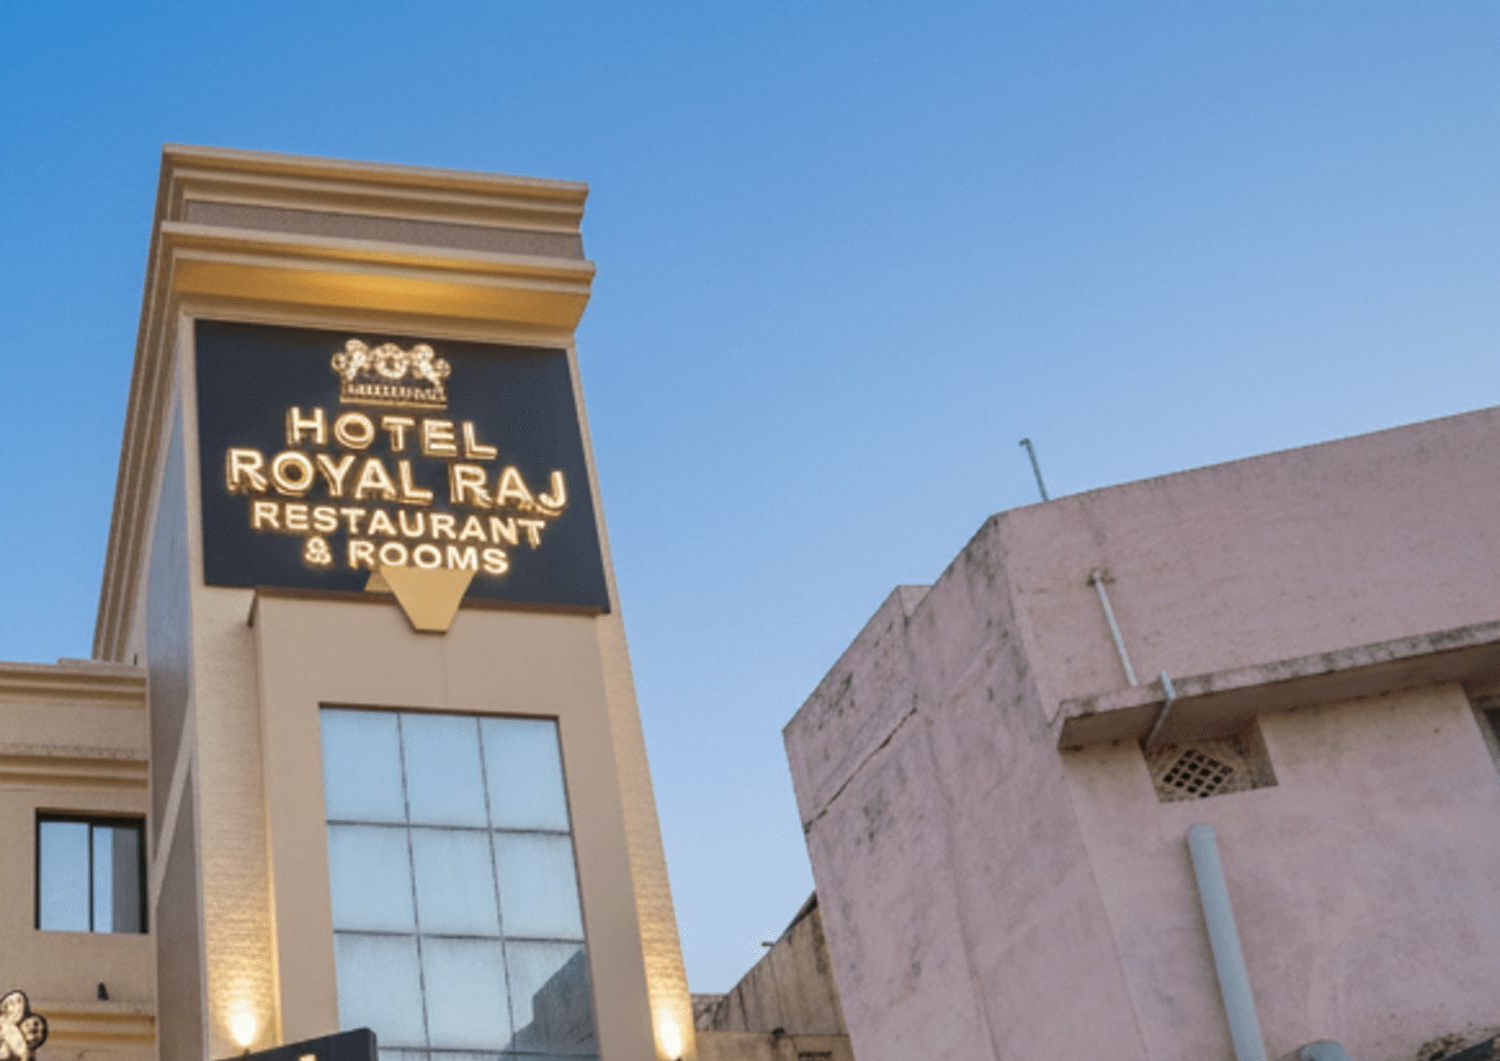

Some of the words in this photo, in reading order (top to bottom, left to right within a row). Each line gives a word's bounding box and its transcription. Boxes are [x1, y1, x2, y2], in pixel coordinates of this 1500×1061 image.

[286, 406, 498, 460] HOTEL
[227, 447, 434, 505] ROYAL
[451, 464, 568, 516] RAJ
[252, 500, 547, 548] RESTAURANT
[304, 537, 332, 565] &
[348, 540, 509, 575] ROOMS
